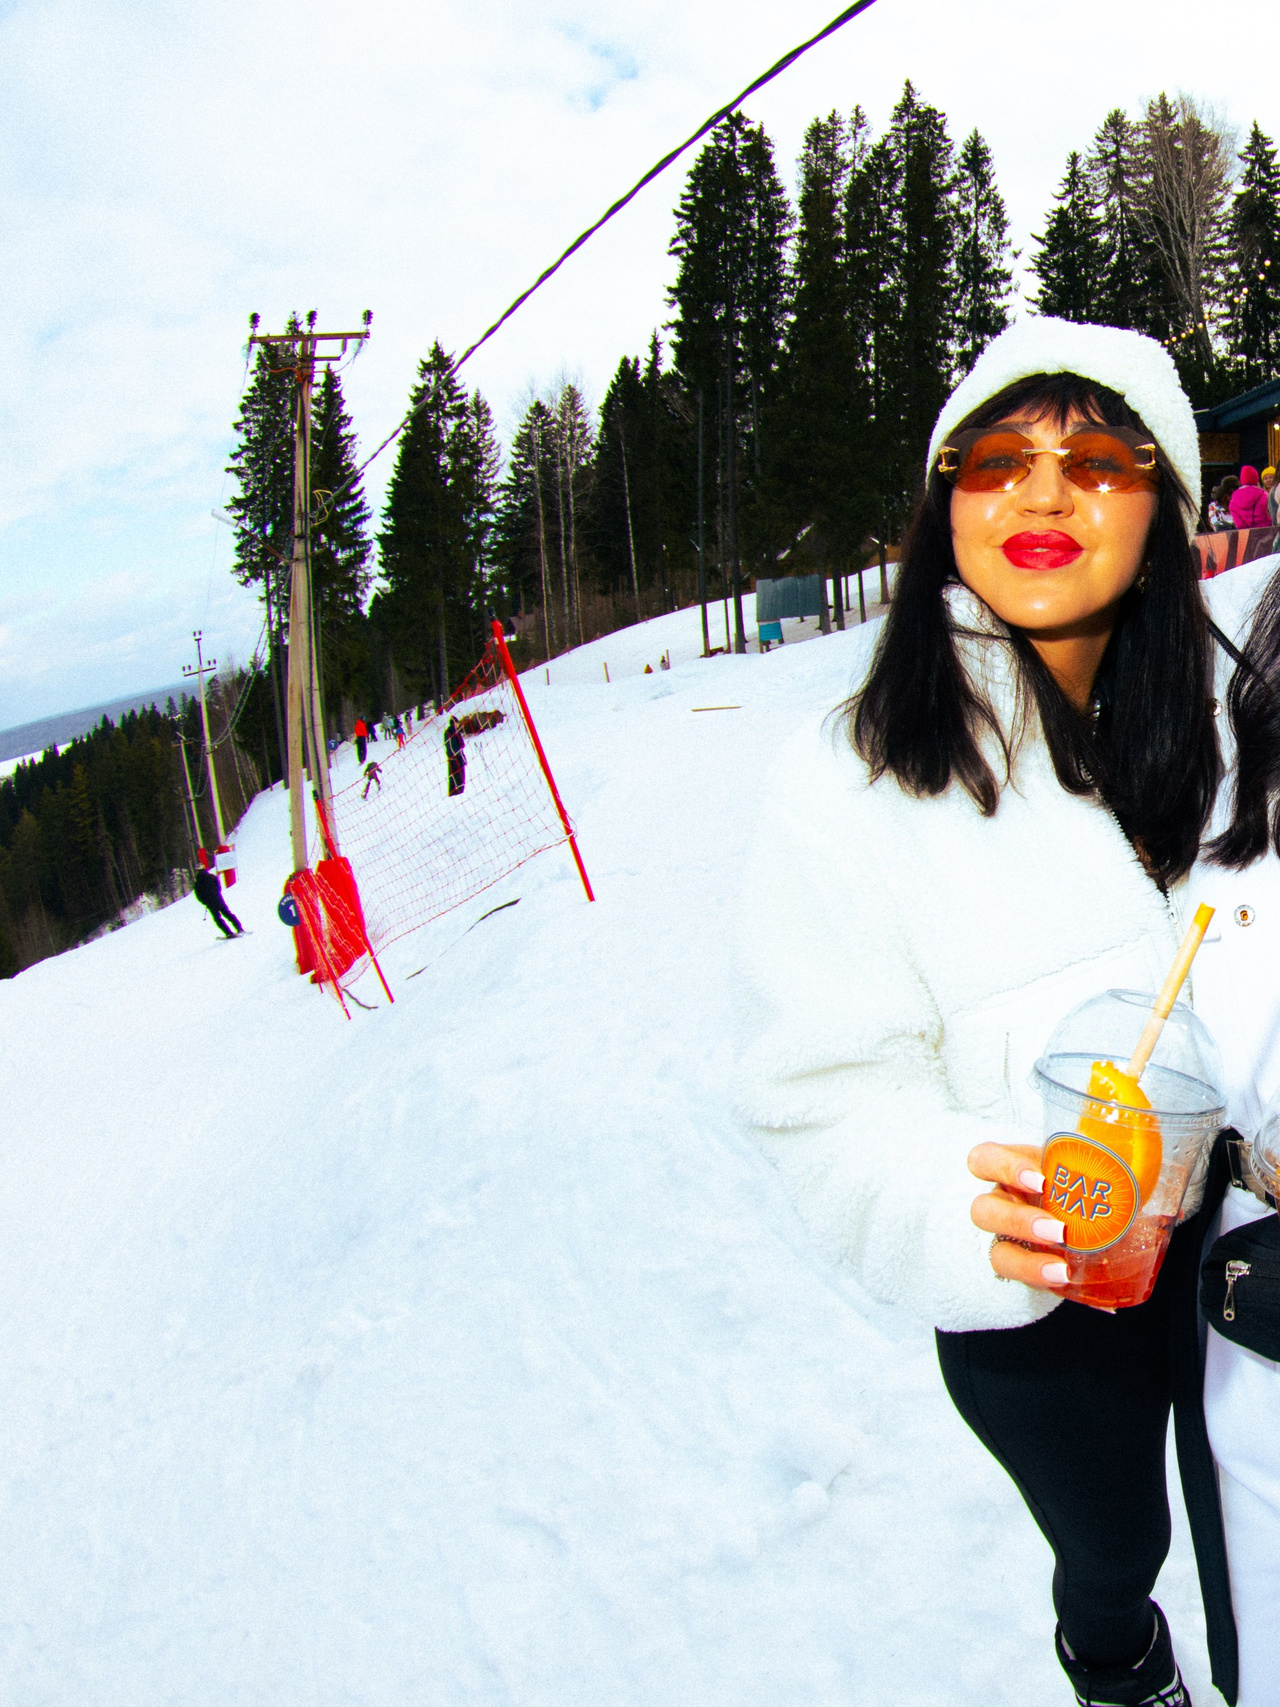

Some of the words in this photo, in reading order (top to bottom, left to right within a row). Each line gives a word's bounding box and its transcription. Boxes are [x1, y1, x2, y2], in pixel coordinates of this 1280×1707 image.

[288, 904, 297, 917] 1
[1054, 1165, 1112, 1203] BAR
[1049, 1185, 1112, 1221] MAP
